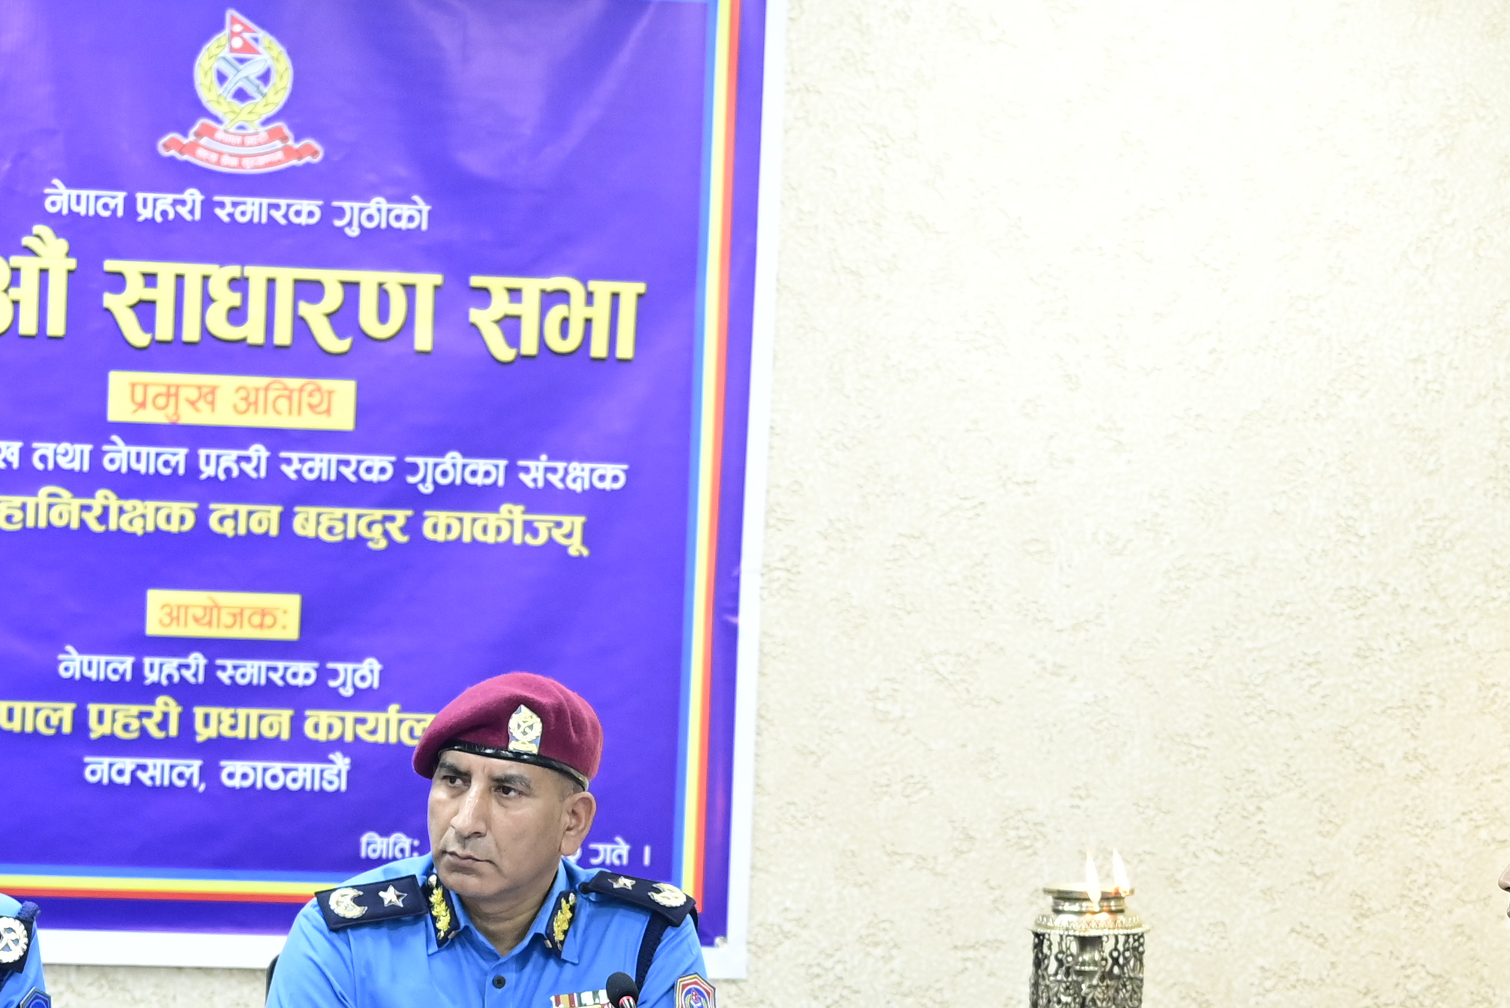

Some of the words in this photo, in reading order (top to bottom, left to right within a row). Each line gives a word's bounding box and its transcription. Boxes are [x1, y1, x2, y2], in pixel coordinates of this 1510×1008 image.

[44, 179, 127, 218] नेपाल
[136, 189, 204, 222] प्रहरी
[214, 196, 323, 225] स्मारक
[332, 195, 431, 238] गुठीको
[103, 259, 443, 353] साधारण
[469, 273, 645, 363] सभा
[130, 382, 219, 424] प्रमुख
[234, 380, 335, 417] अतिथि
[32, 442, 93, 472] तथा
[102, 435, 189, 476] नेपाल
[198, 444, 270, 480] प्रहरी
[279, 452, 396, 484] स्मारक
[405, 451, 508, 494] गुठीका
[517, 454, 629, 492] संरक्षक
[208, 503, 284, 538] दान
[293, 507, 413, 550] बहादुर
[422, 503, 591, 557] कार्कीज्यू
[58, 645, 135, 683] नेपाल
[143, 652, 207, 686] प्रहरी
[216, 659, 319, 688] स्मारक
[326, 657, 382, 697] गुठी
[87, 695, 183, 740] प्रहरी
[194, 706, 294, 744] प्रधान
[304, 704, 434, 745] कार्याल
[83, 755, 206, 792] नक्साल,
[220, 752, 351, 791] काठमाडौं
[589, 837, 631, 866] गते
